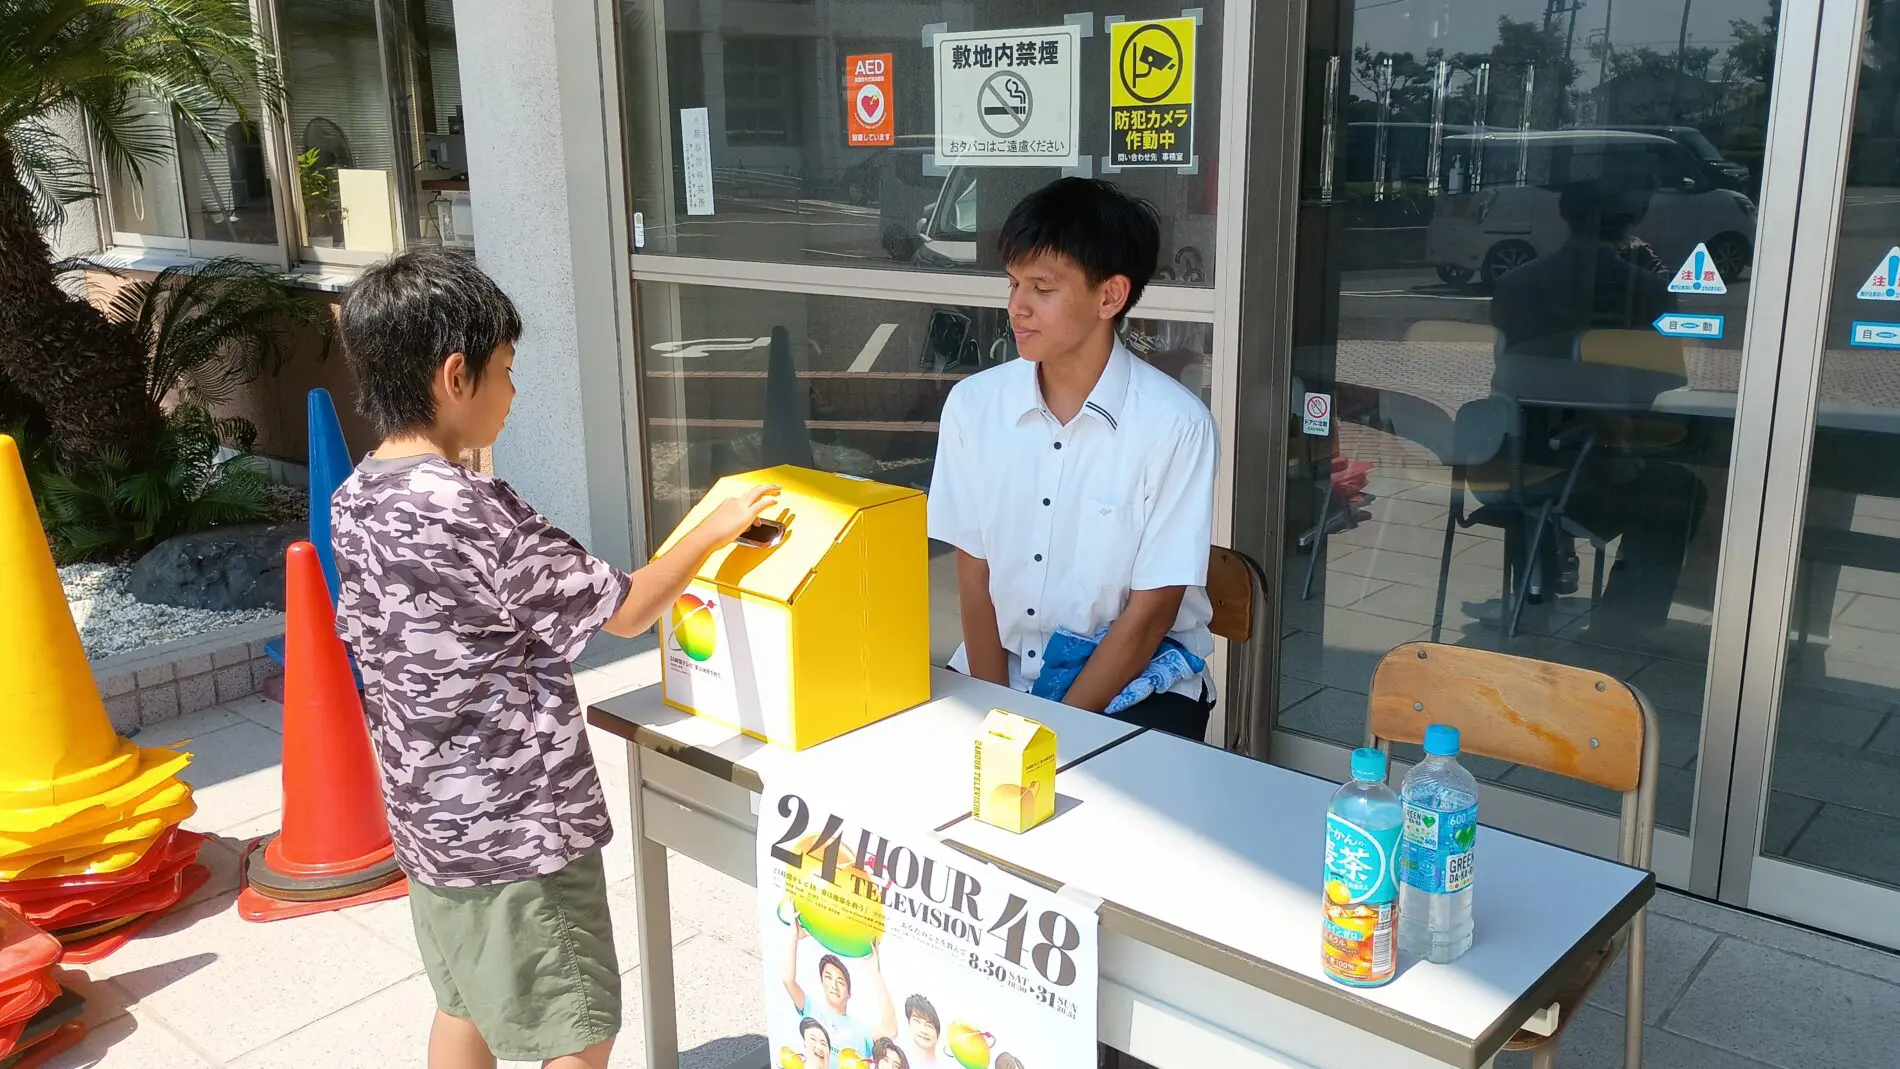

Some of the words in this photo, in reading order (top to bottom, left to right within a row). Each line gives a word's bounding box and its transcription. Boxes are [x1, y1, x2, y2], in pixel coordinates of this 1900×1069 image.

[952, 40, 1059, 70] 敷地内禁煙
[854, 59, 885, 75] AED
[1114, 109, 1188, 131] 防犯カメラ
[950, 139, 1065, 153] おタバコはご遠慮ください
[1125, 129, 1175, 151] 作動中
[1117, 152, 1158, 162] 問い合わせ先
[1450, 813, 1466, 826] 600
[771, 794, 845, 888] 24
[852, 827, 984, 922] HOUR
[987, 893, 1081, 987] 48
[850, 874, 985, 947] TELEVISION
[968, 952, 1007, 982] 8.30
[1008, 970, 1030, 987] SAT
[1035, 985, 1057, 1009] 31
[1057, 996, 1079, 1013] SUN
